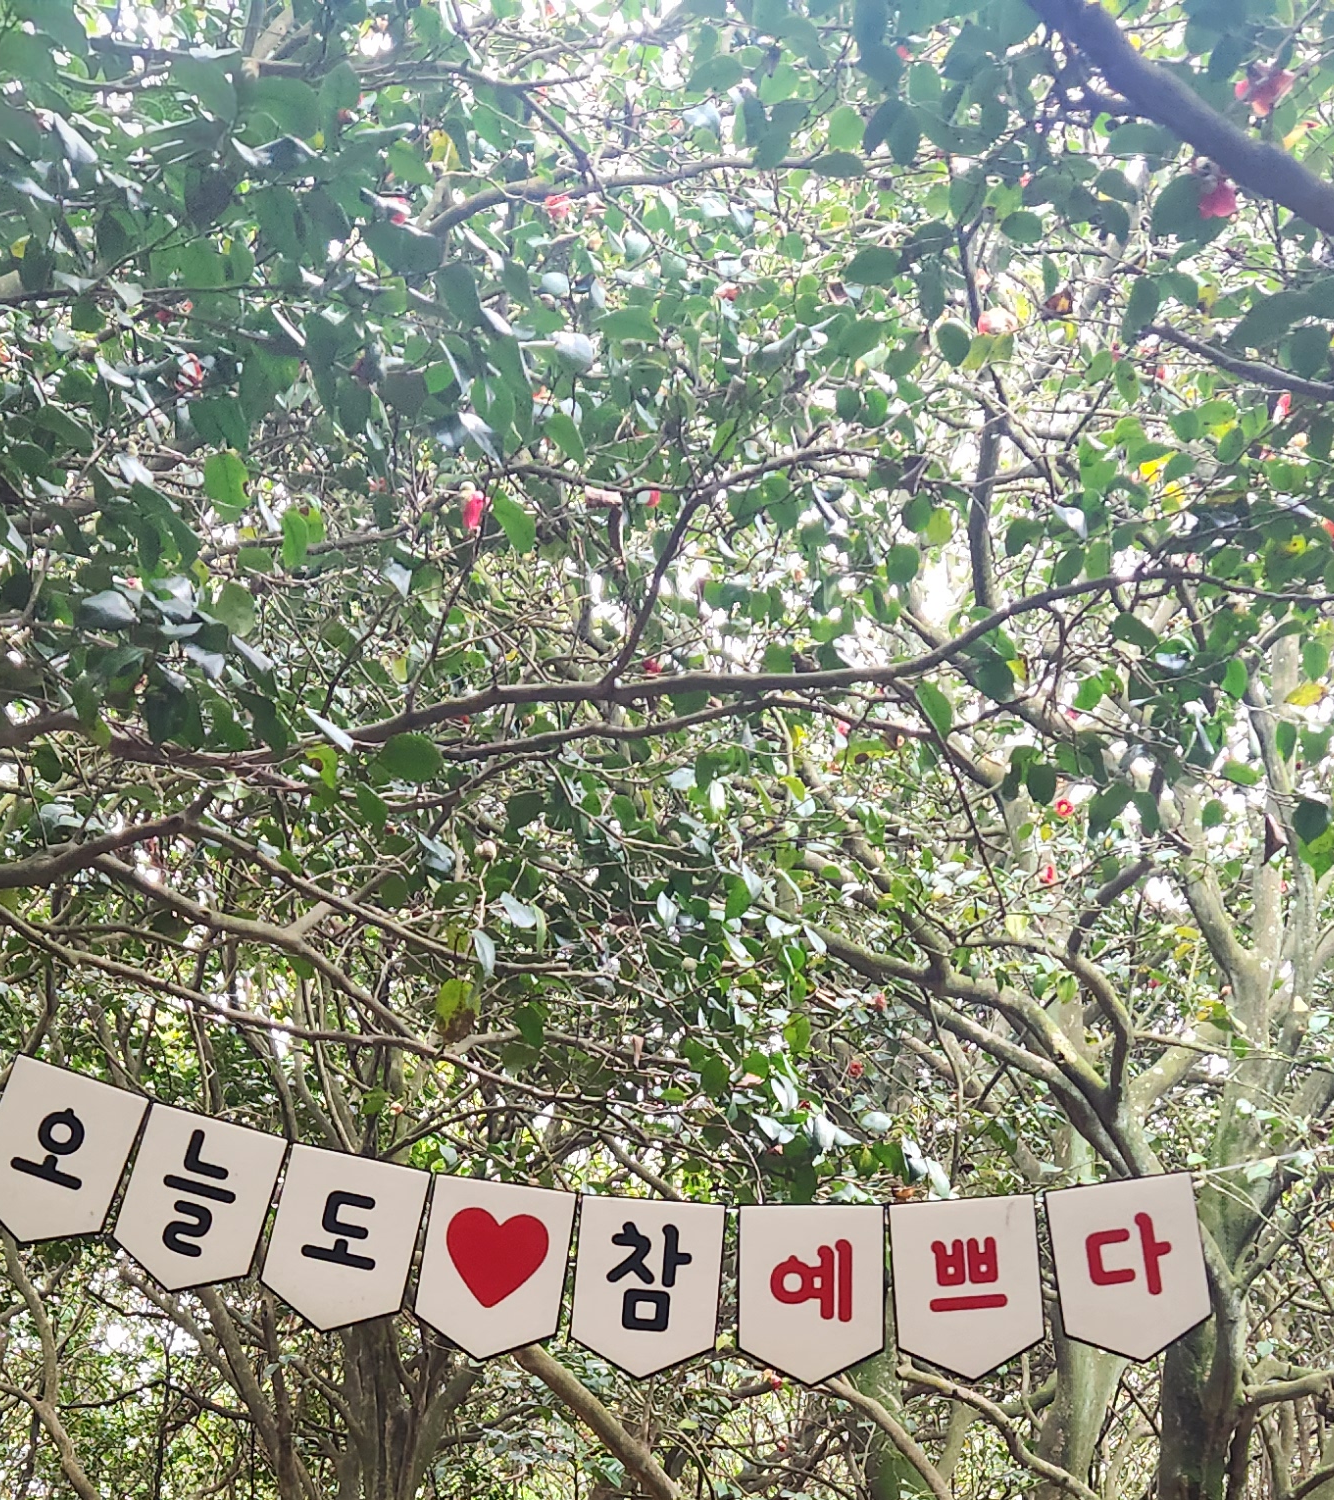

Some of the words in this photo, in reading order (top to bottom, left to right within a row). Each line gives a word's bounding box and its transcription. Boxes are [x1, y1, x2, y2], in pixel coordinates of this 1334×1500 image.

[10, 1107, 376, 1271] 오늘도
[606, 1222, 692, 1332] 참
[770, 1211, 1172, 1322] 예쁘다
